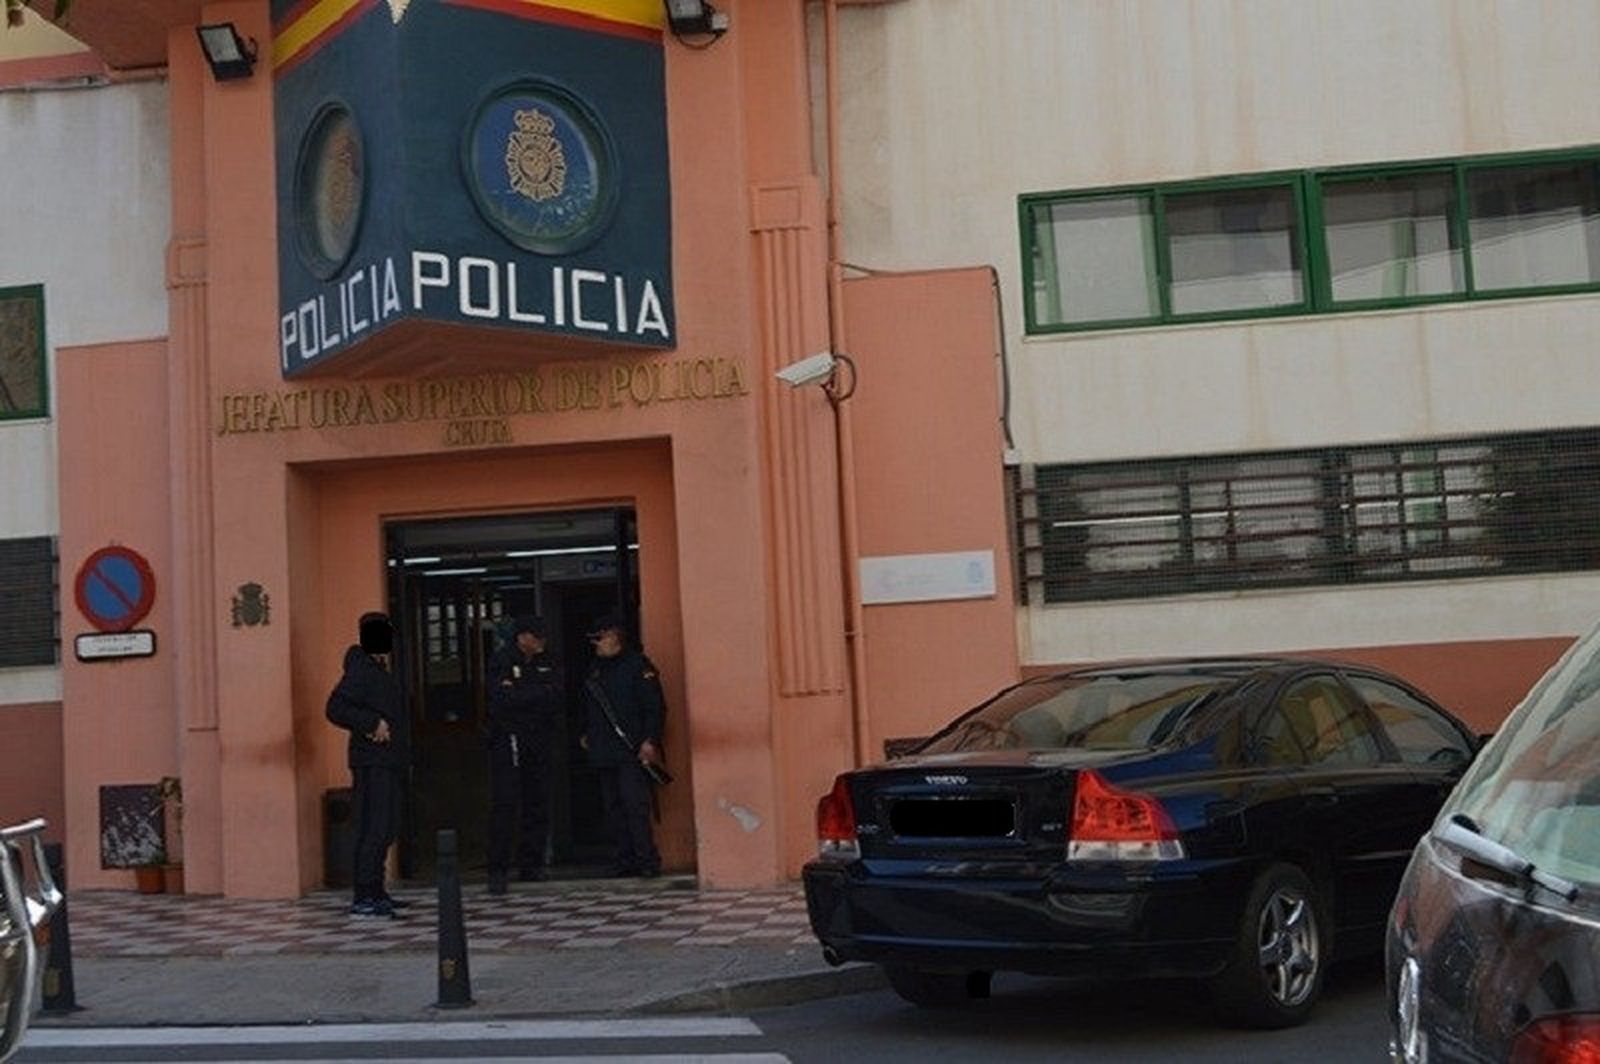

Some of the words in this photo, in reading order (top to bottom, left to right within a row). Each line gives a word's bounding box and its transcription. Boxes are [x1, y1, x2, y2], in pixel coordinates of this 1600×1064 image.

[281, 257, 401, 370] POLICIA
[412, 250, 669, 337] POLICIA
[218, 390, 377, 437] JEFATURA
[380, 371, 545, 423] SUPERIOR
[554, 367, 600, 411] DE
[611, 356, 750, 406] POLICIA
